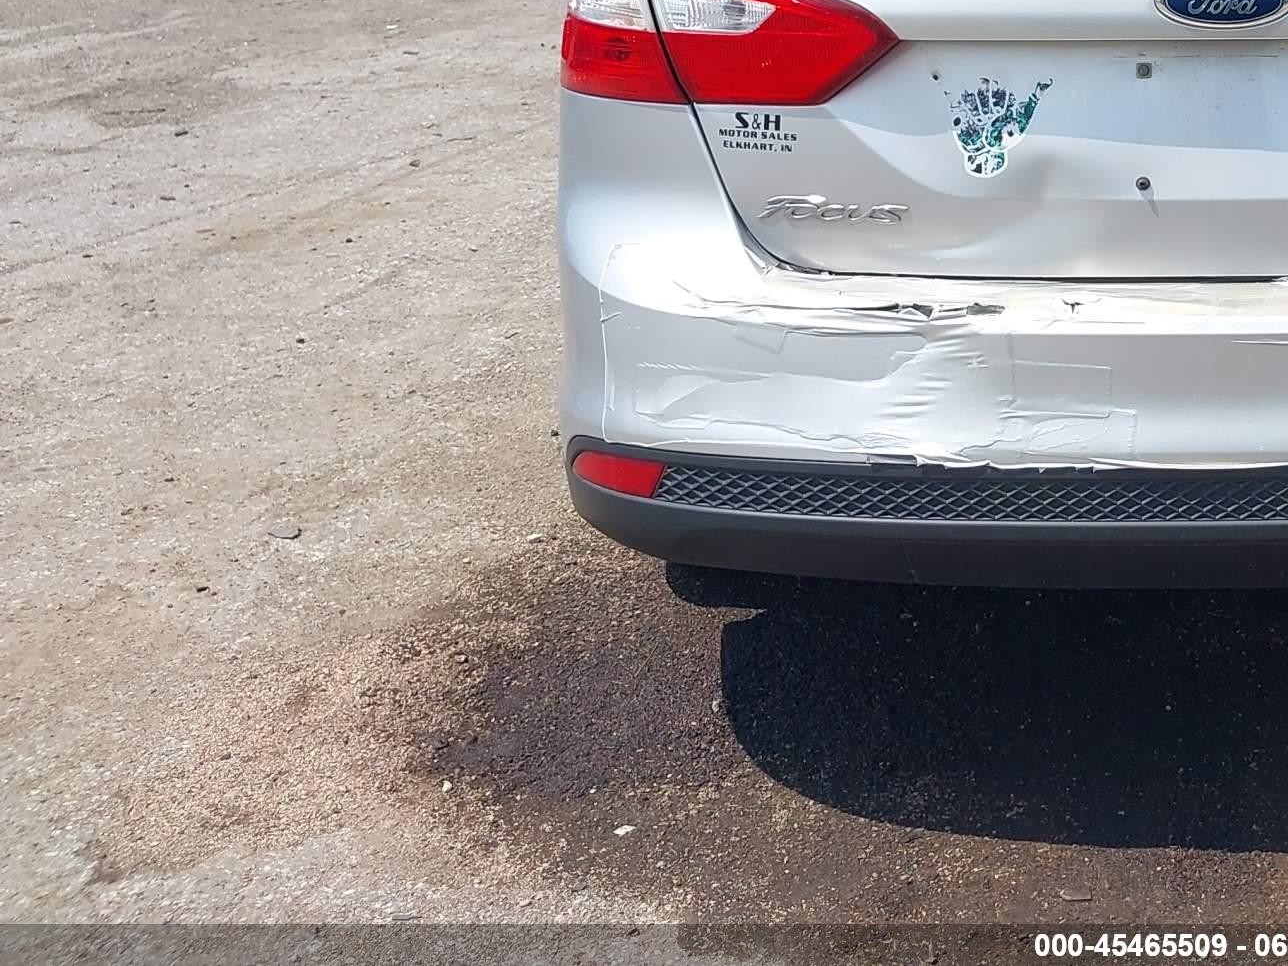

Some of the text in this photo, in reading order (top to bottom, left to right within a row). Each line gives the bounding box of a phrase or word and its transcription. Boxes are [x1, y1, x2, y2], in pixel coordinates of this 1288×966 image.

[735, 112, 781, 131] S&H
[719, 129, 797, 141] MOTOR SALES
[723, 140, 777, 152] ELKHART,
